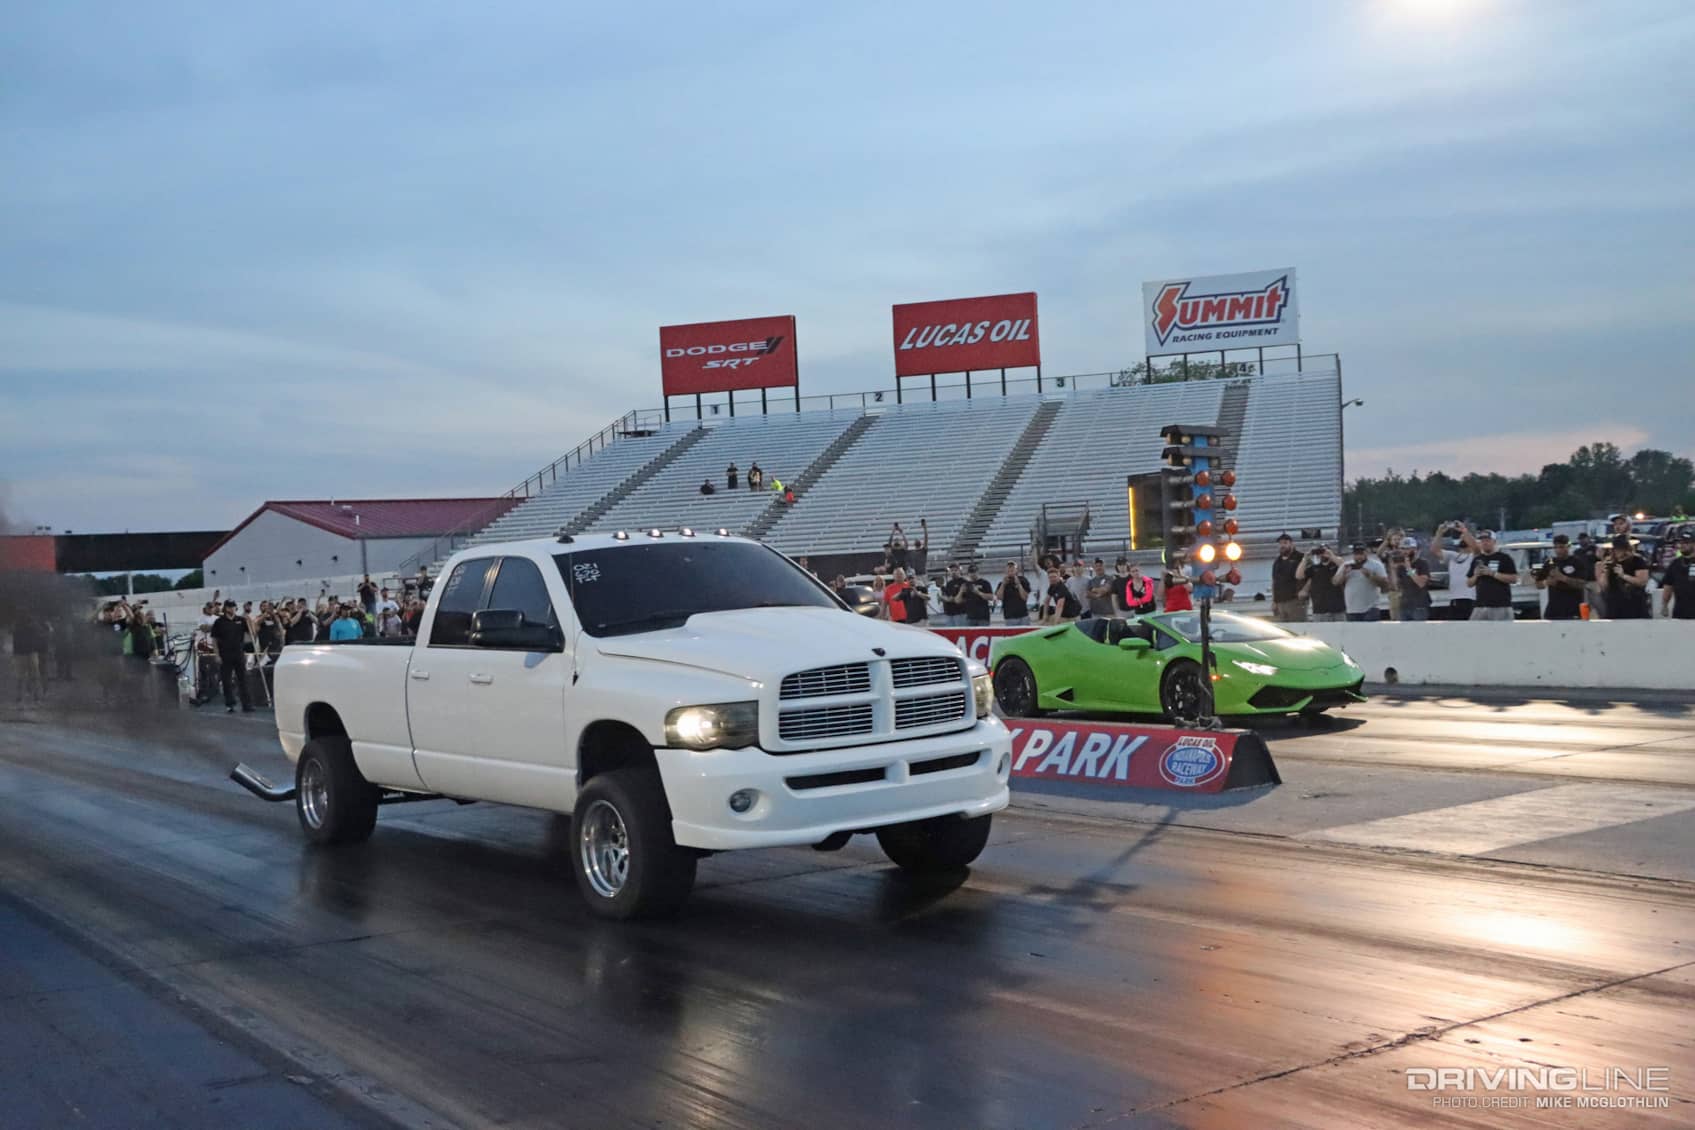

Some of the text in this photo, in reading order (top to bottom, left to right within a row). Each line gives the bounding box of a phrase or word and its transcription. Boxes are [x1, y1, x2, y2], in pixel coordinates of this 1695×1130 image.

[900, 319, 1031, 350] LUCAS OIL
[1172, 327, 1280, 343] RACING EQUIPMENT
[666, 340, 769, 358] DODGE
[702, 357, 760, 369] SRT
[875, 391, 884, 402] 2
[1013, 729, 1149, 780] PARK
